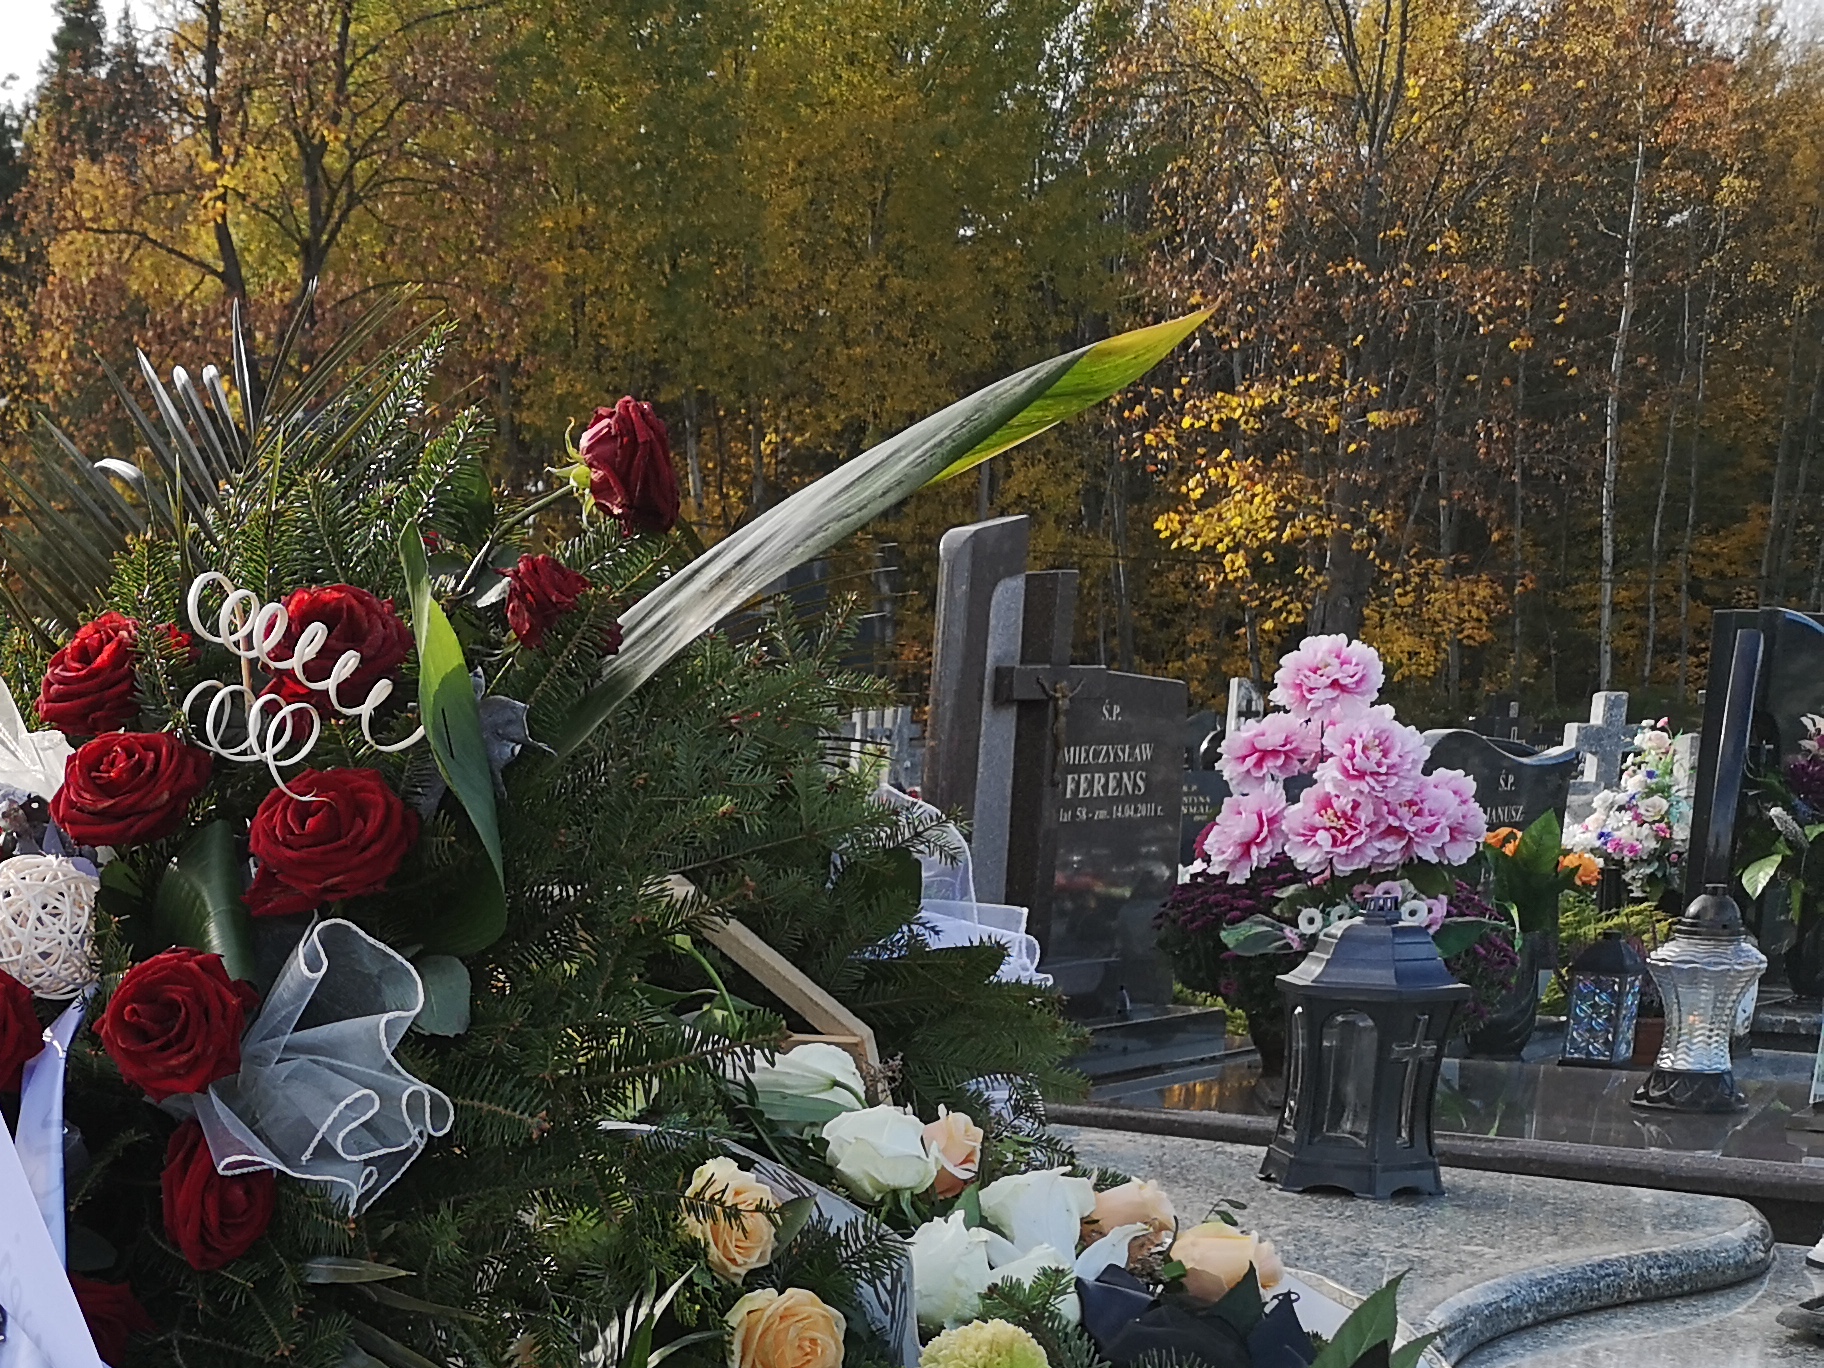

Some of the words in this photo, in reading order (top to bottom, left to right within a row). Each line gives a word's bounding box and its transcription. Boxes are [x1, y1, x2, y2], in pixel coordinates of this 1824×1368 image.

[1063, 743, 1154, 765] MIECZYSŁAW
[1065, 771, 1147, 799] FERENS
[1059, 807, 1072, 822] lat
